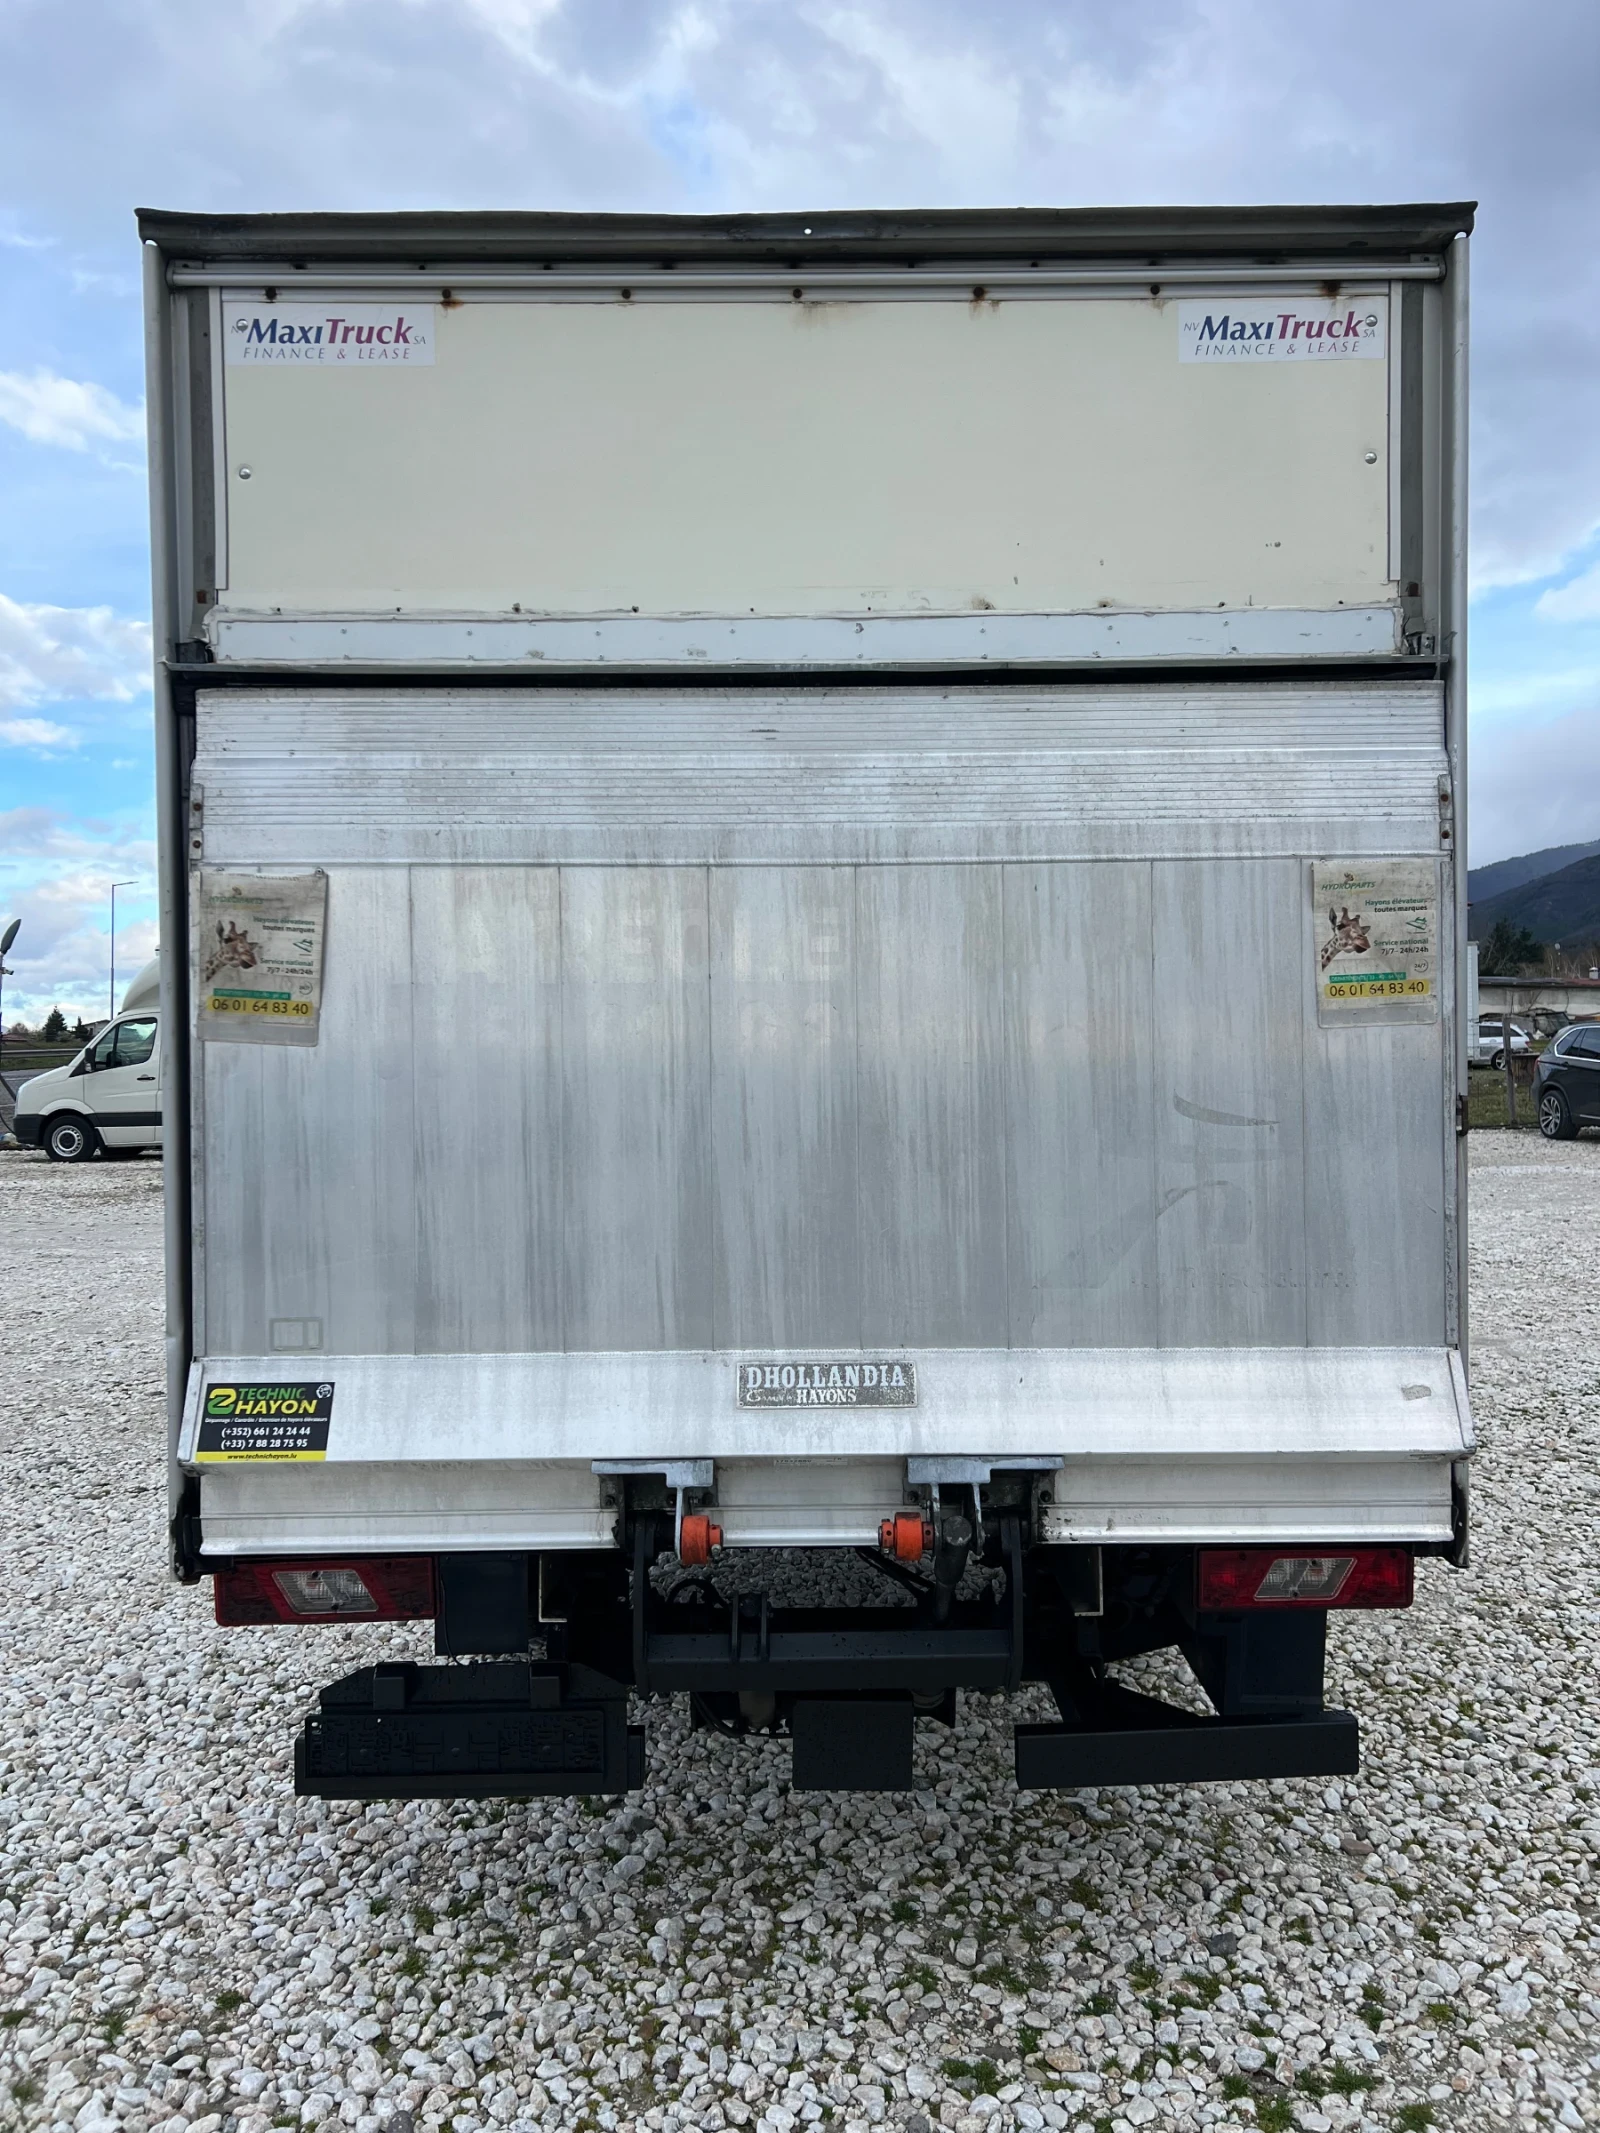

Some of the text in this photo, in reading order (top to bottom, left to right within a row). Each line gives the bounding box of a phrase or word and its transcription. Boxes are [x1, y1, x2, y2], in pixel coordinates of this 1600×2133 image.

[246, 317, 414, 345] MaxiTruck
[413, 335, 426, 345] SA
[1184, 311, 1376, 341] NV MaxiTruck SA
[243, 347, 410, 359] FINANCE & LEASE
[1195, 341, 1360, 356] FINANCE & LEASE
[1321, 881, 1376, 890] HYDROPARTS
[1365, 899, 1391, 907] Hayons
[1397, 905, 1428, 913] marques
[1330, 981, 1425, 997] 06 01 64 83 40
[212, 999, 309, 1015] 06 01 64 83 40
[746, 1365, 906, 1388] DHOLLANDIA
[239, 1387, 306, 1400] TECHNIC
[796, 1388, 858, 1404] HAYONS
[234, 1400, 317, 1414] HAYON
[221, 1426, 311, 1438] (+352) 661 24 24 44
[220, 1439, 308, 1450] (+33) 7 88 28 75 95
